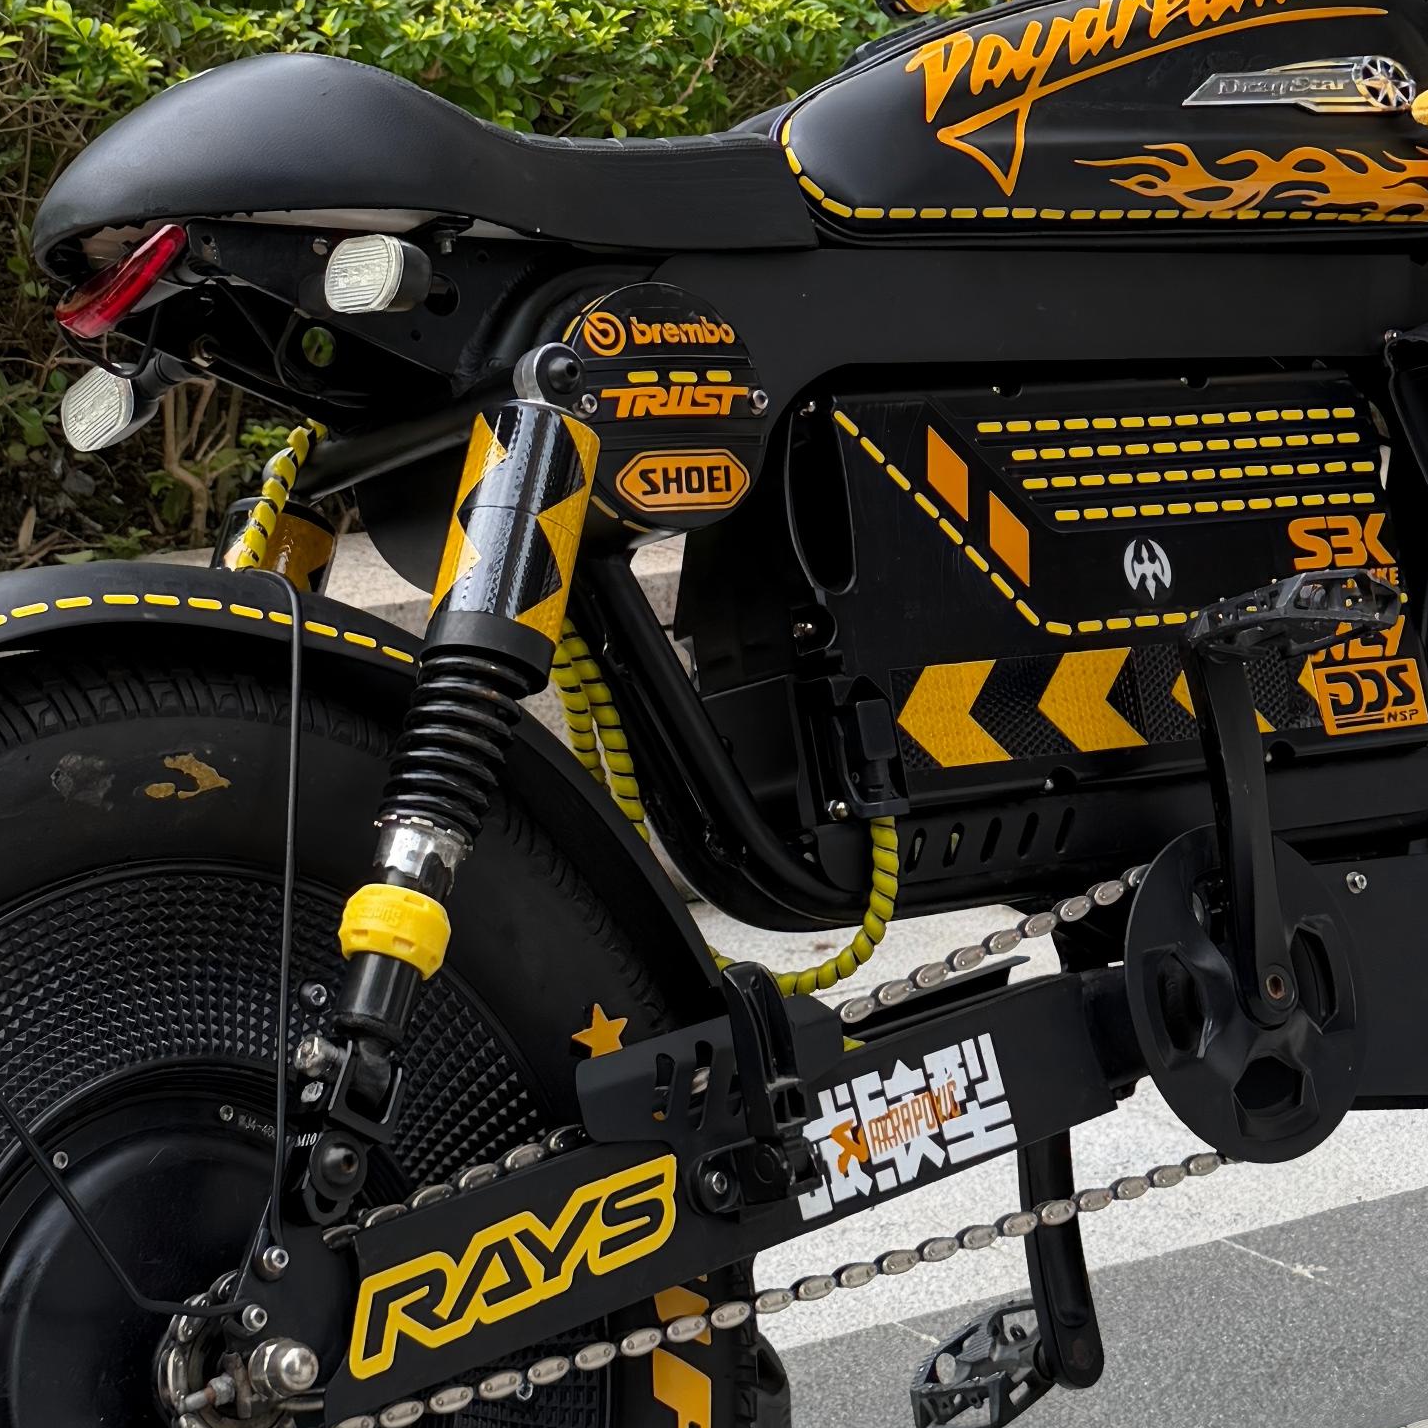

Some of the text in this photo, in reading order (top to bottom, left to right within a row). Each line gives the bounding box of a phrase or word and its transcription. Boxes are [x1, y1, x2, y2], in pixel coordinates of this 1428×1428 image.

[629, 316, 735, 345] brembo
[600, 386, 749, 418] TRUST
[639, 465, 732, 496] SHOEI
[1288, 513, 1396, 570] SBK
[1387, 709, 1419, 722] NSP
[356, 1164, 672, 1372] RAYS
